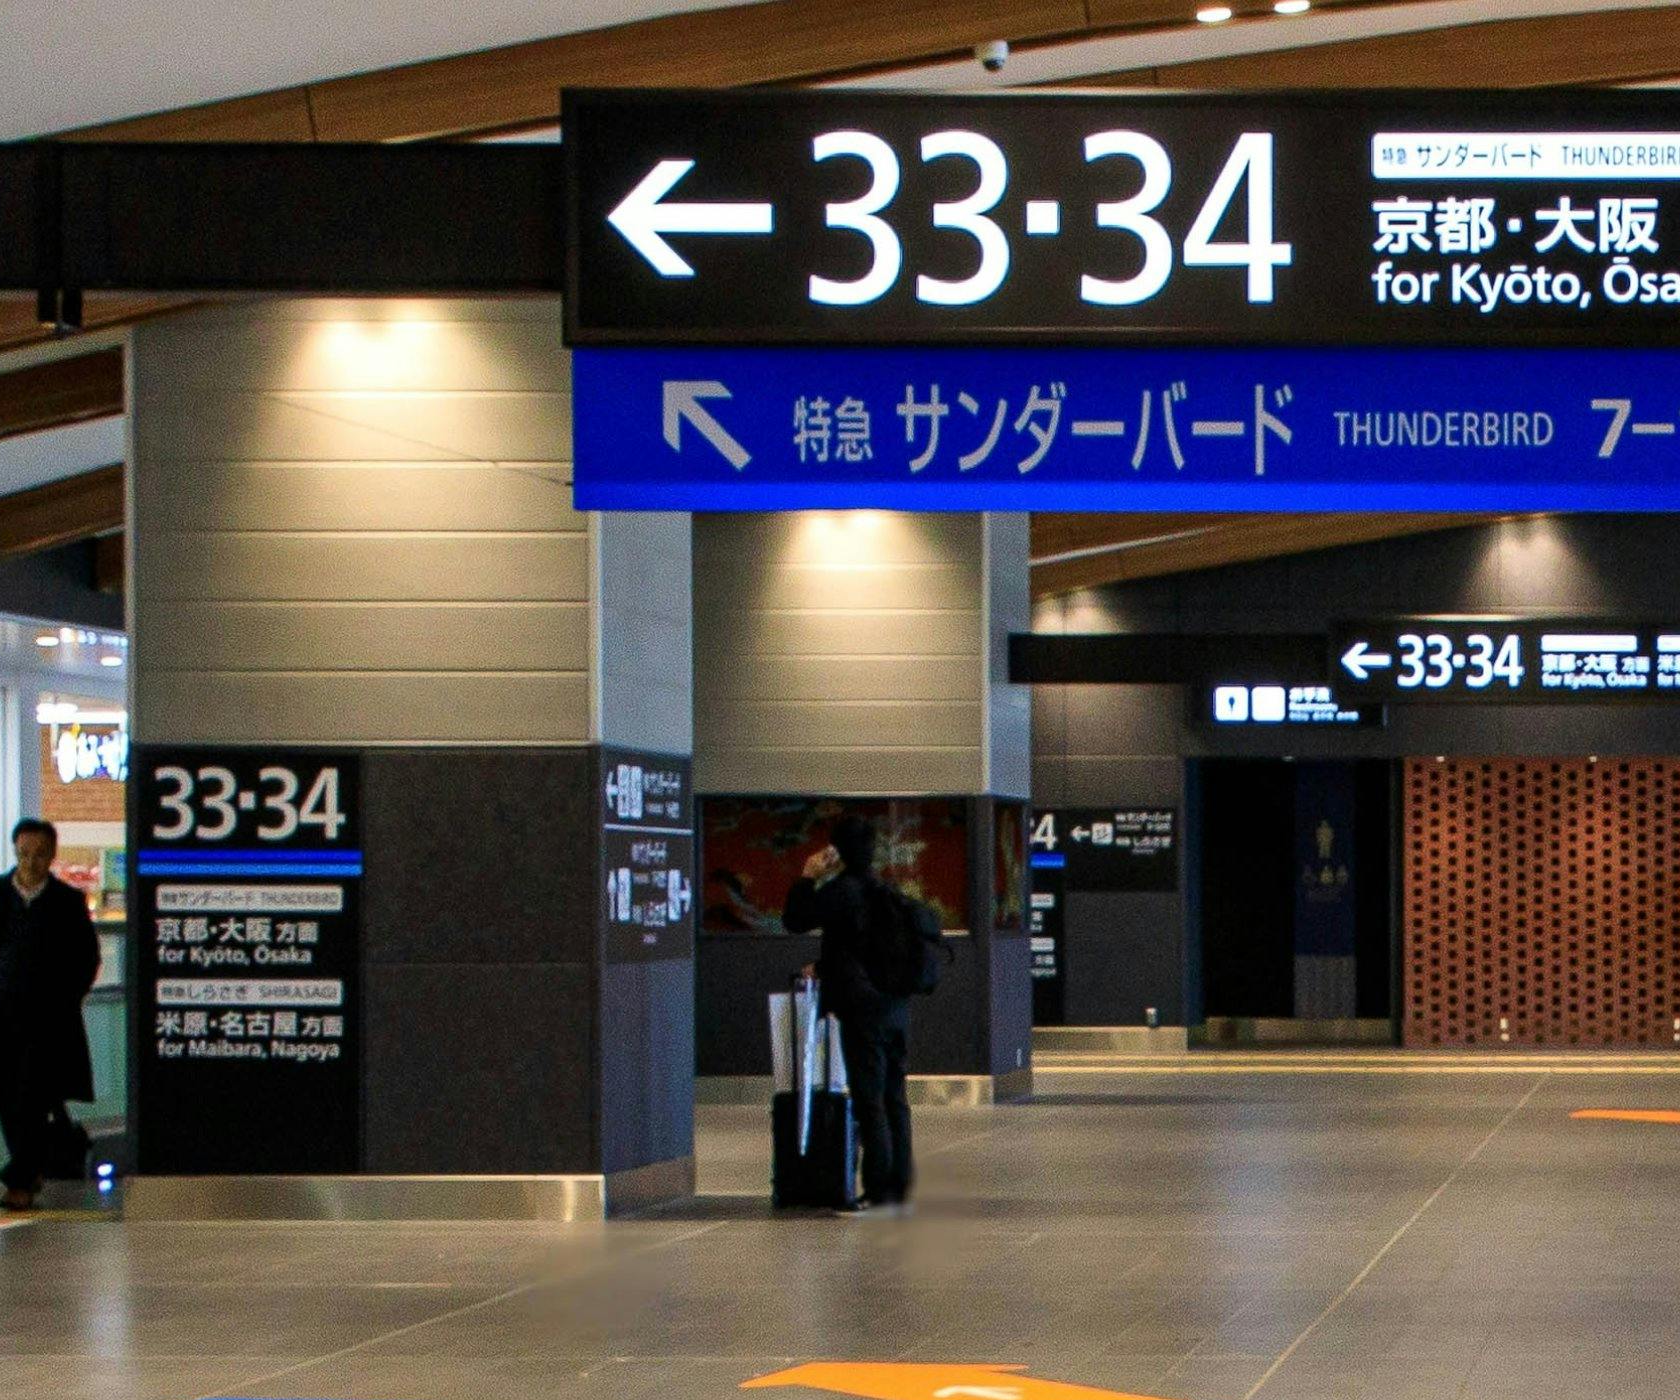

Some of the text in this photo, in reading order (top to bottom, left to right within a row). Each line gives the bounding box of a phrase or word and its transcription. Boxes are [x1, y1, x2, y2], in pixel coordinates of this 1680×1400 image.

[1417, 145, 1542, 167] サンダーバード
[1372, 196, 1660, 253] 京都・大阪
[1372, 260, 1439, 303] for
[1451, 263, 1592, 313] Kyōto,
[793, 396, 873, 462] 特急
[896, 381, 1293, 475] サンダーバード
[1333, 411, 1554, 447] THUNDERBIRD
